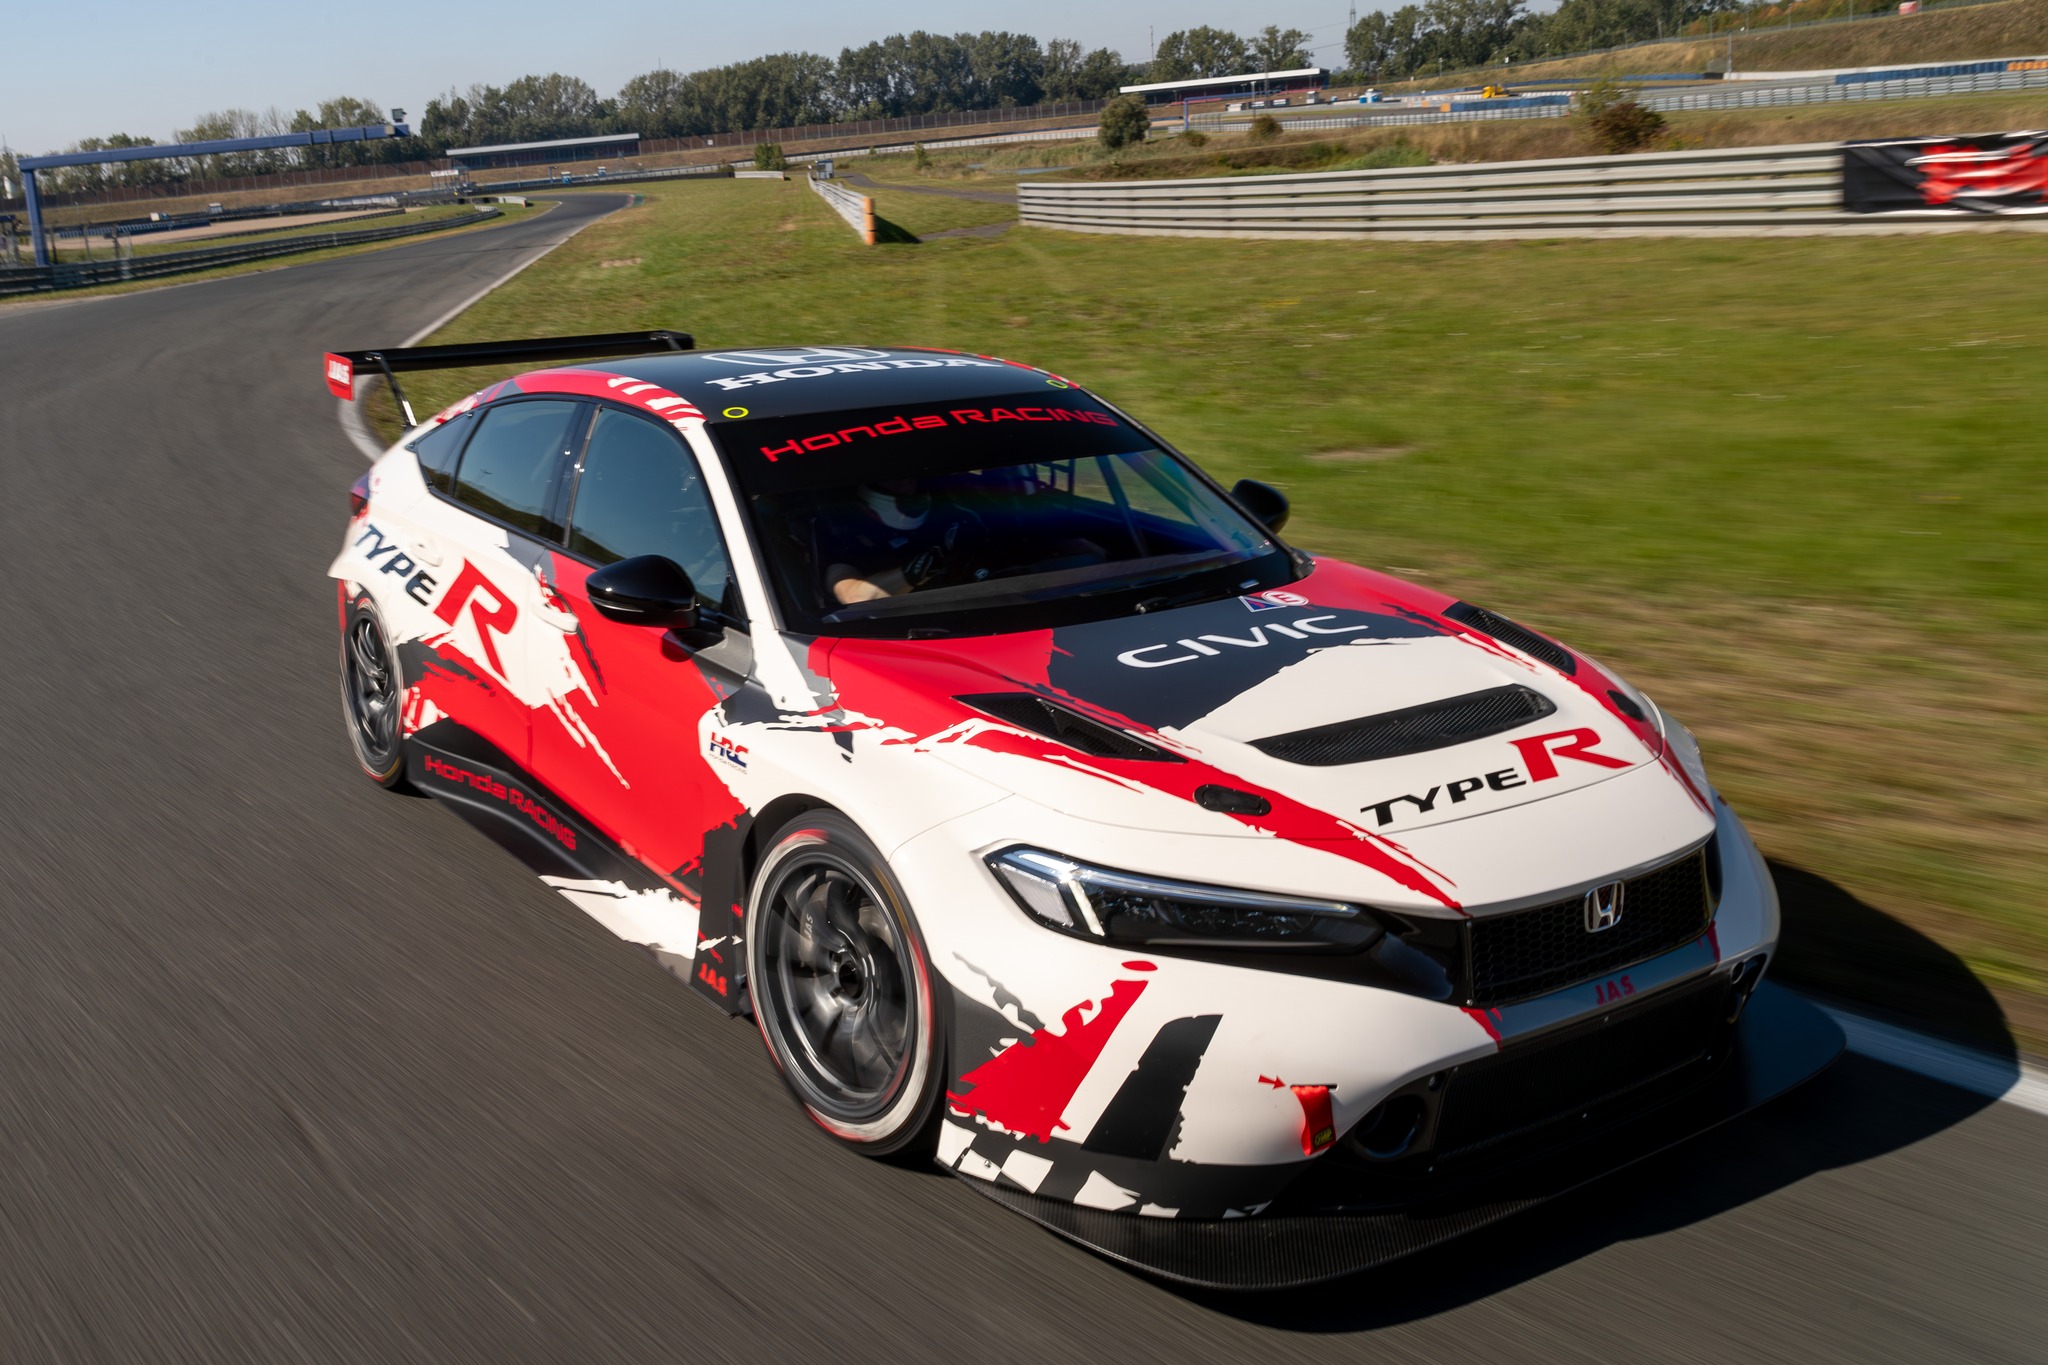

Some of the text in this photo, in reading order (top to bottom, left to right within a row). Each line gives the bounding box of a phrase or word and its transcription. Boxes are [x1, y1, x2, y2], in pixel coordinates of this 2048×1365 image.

[704, 358, 1003, 391] HONDA
[760, 407, 1119, 463] Honda RACING
[354, 523, 518, 683] TYPE R
[1117, 614, 1369, 669] CIVIC
[709, 731, 749, 768] HRC
[1360, 727, 1636, 827] TYPE R
[424, 755, 576, 850] Honda RACING
[1595, 975, 1636, 1005] JAS
